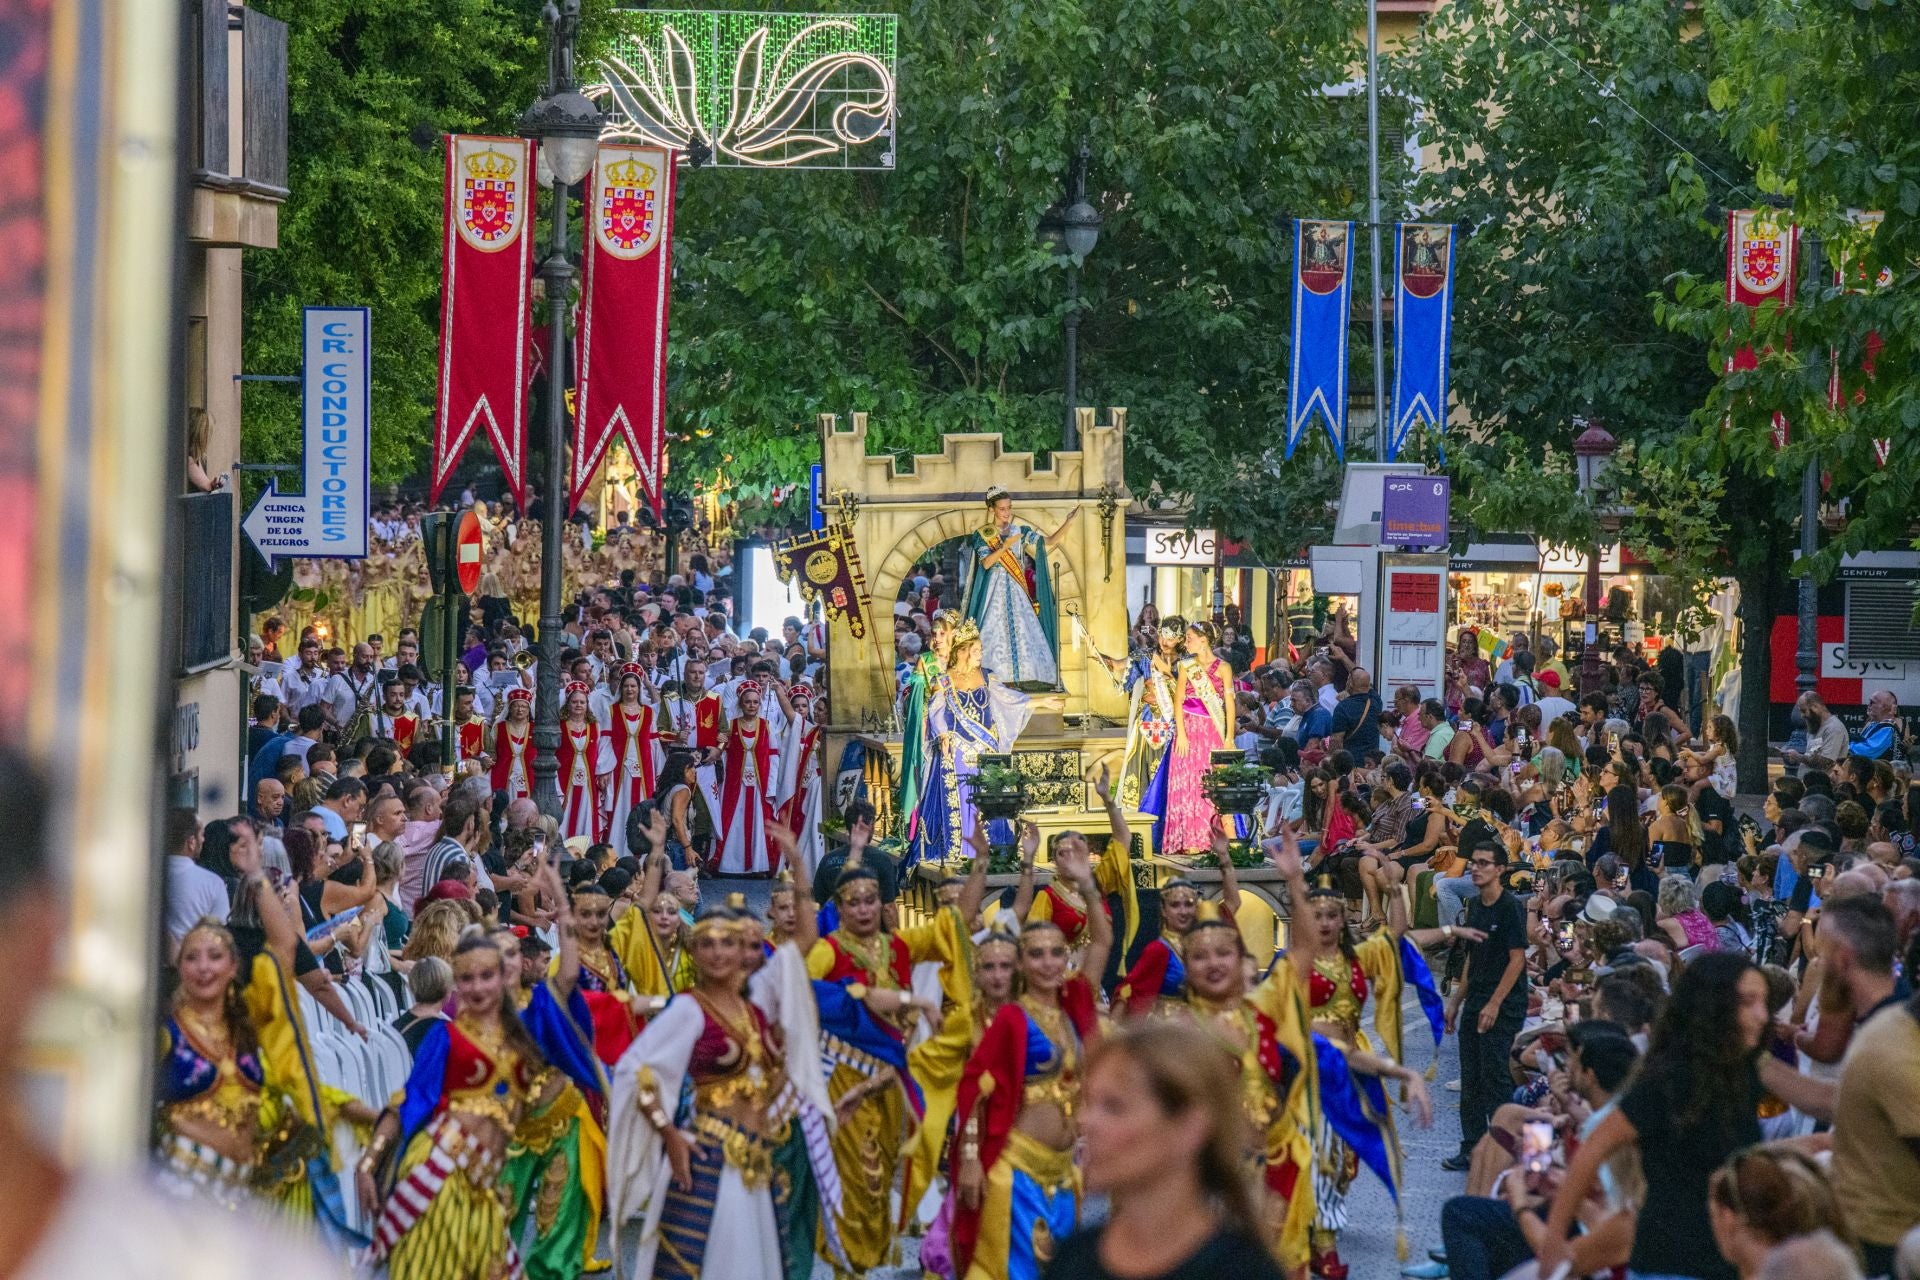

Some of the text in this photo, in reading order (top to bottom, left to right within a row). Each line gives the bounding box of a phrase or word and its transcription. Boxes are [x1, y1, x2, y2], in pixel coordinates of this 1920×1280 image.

[322, 363, 347, 541] CONDUCTORES
[1549, 543, 1611, 567] Stye
[1843, 569, 1888, 577] CENTURY
